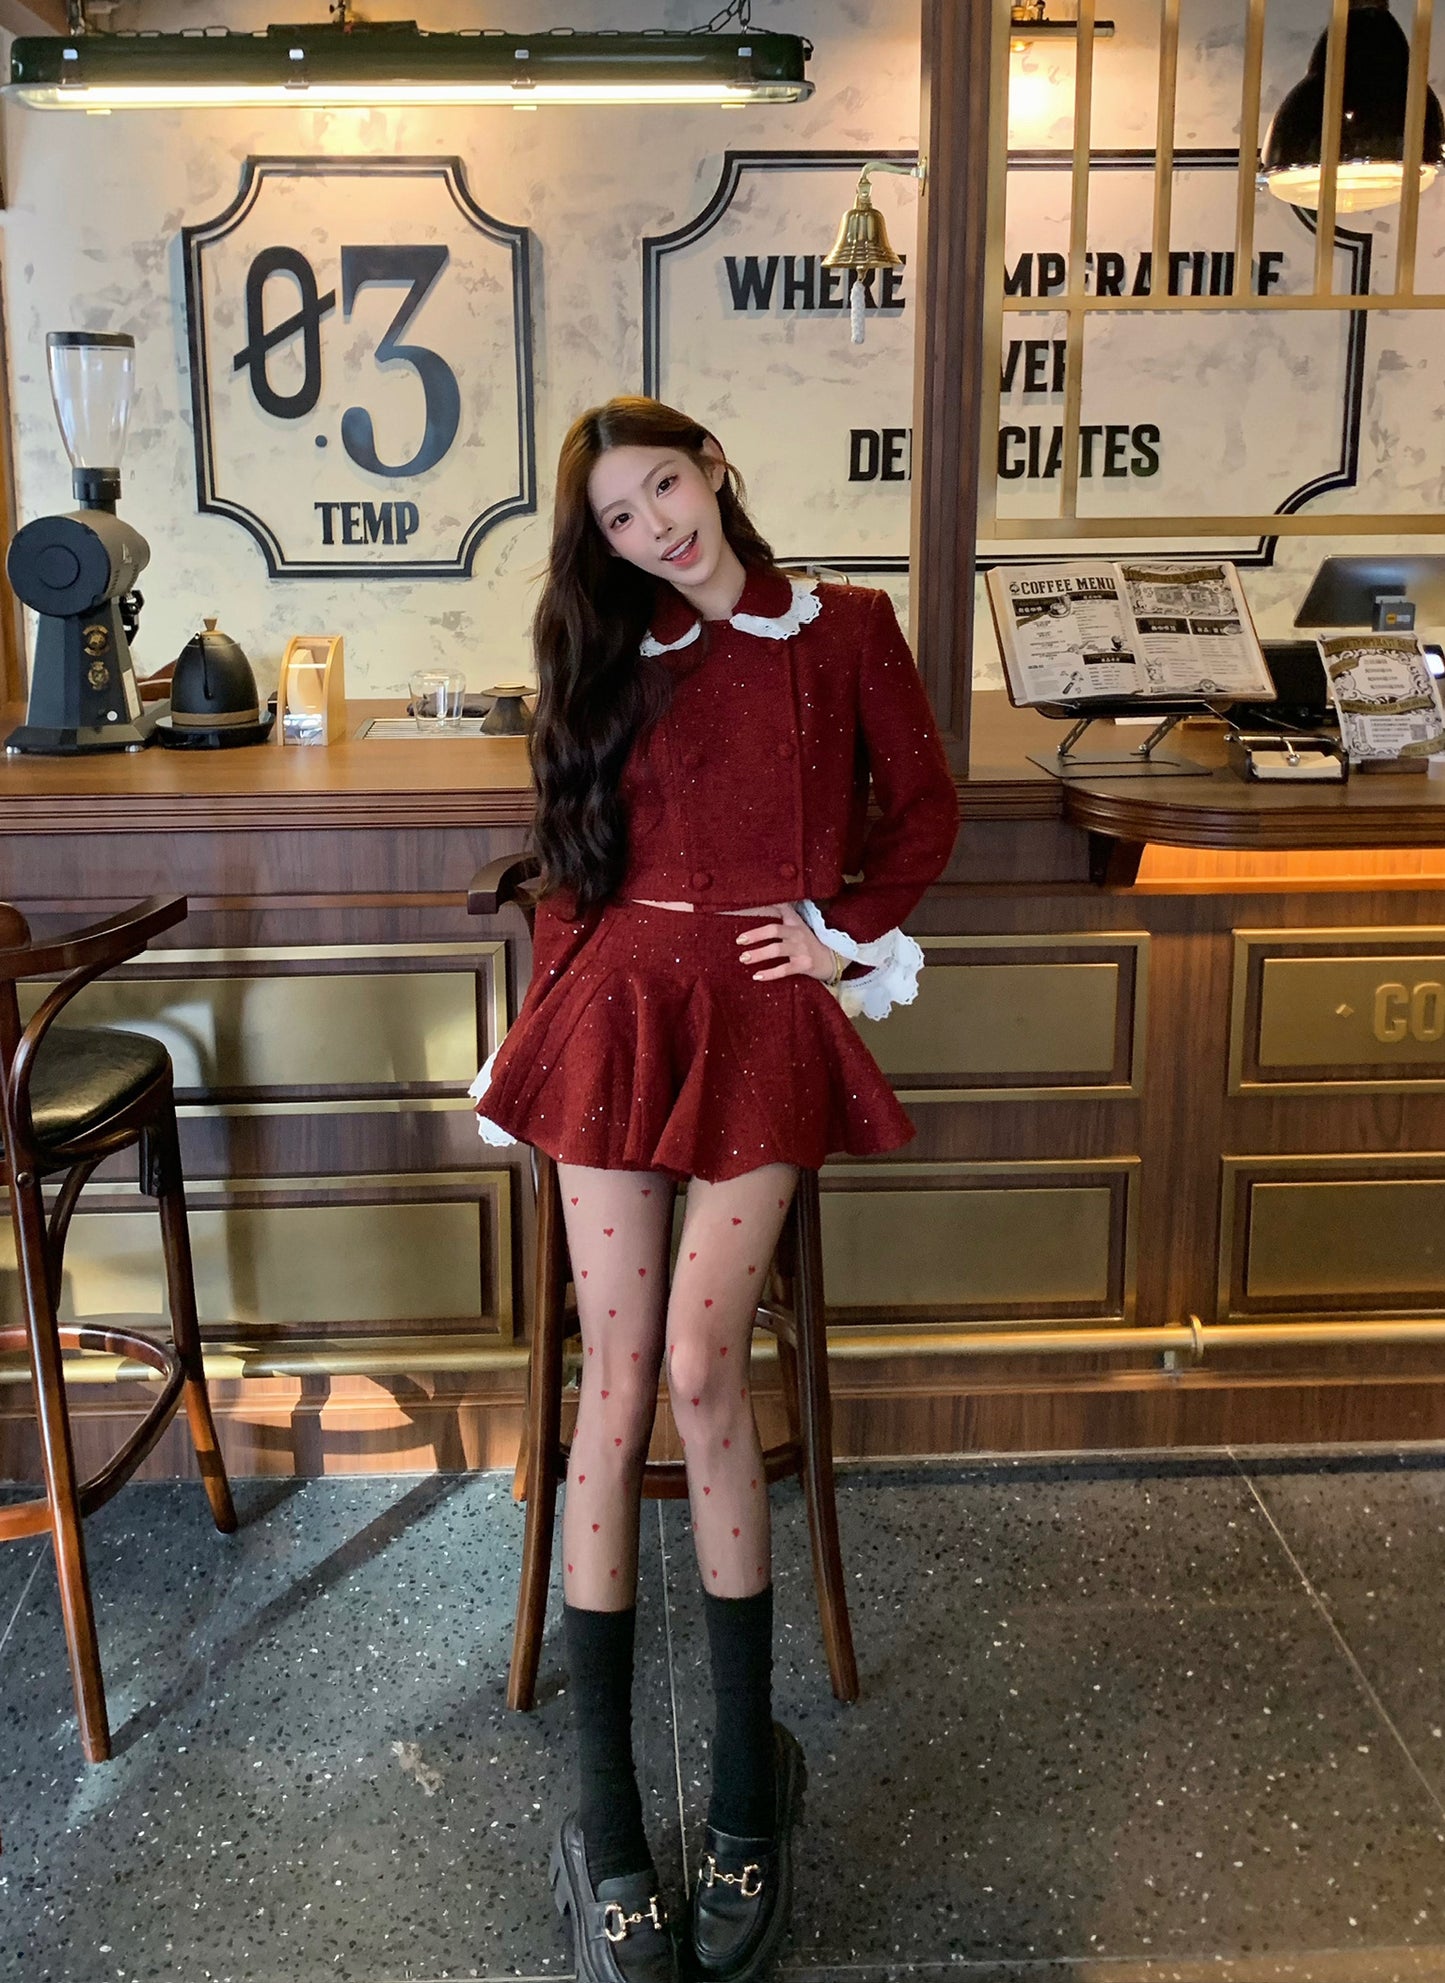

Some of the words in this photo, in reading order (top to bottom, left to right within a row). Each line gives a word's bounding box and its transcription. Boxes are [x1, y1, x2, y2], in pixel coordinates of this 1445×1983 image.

[314, 501, 420, 545] TEMP
[1020, 579, 1073, 595] COFFEE
[1076, 576, 1116, 592] MENU
